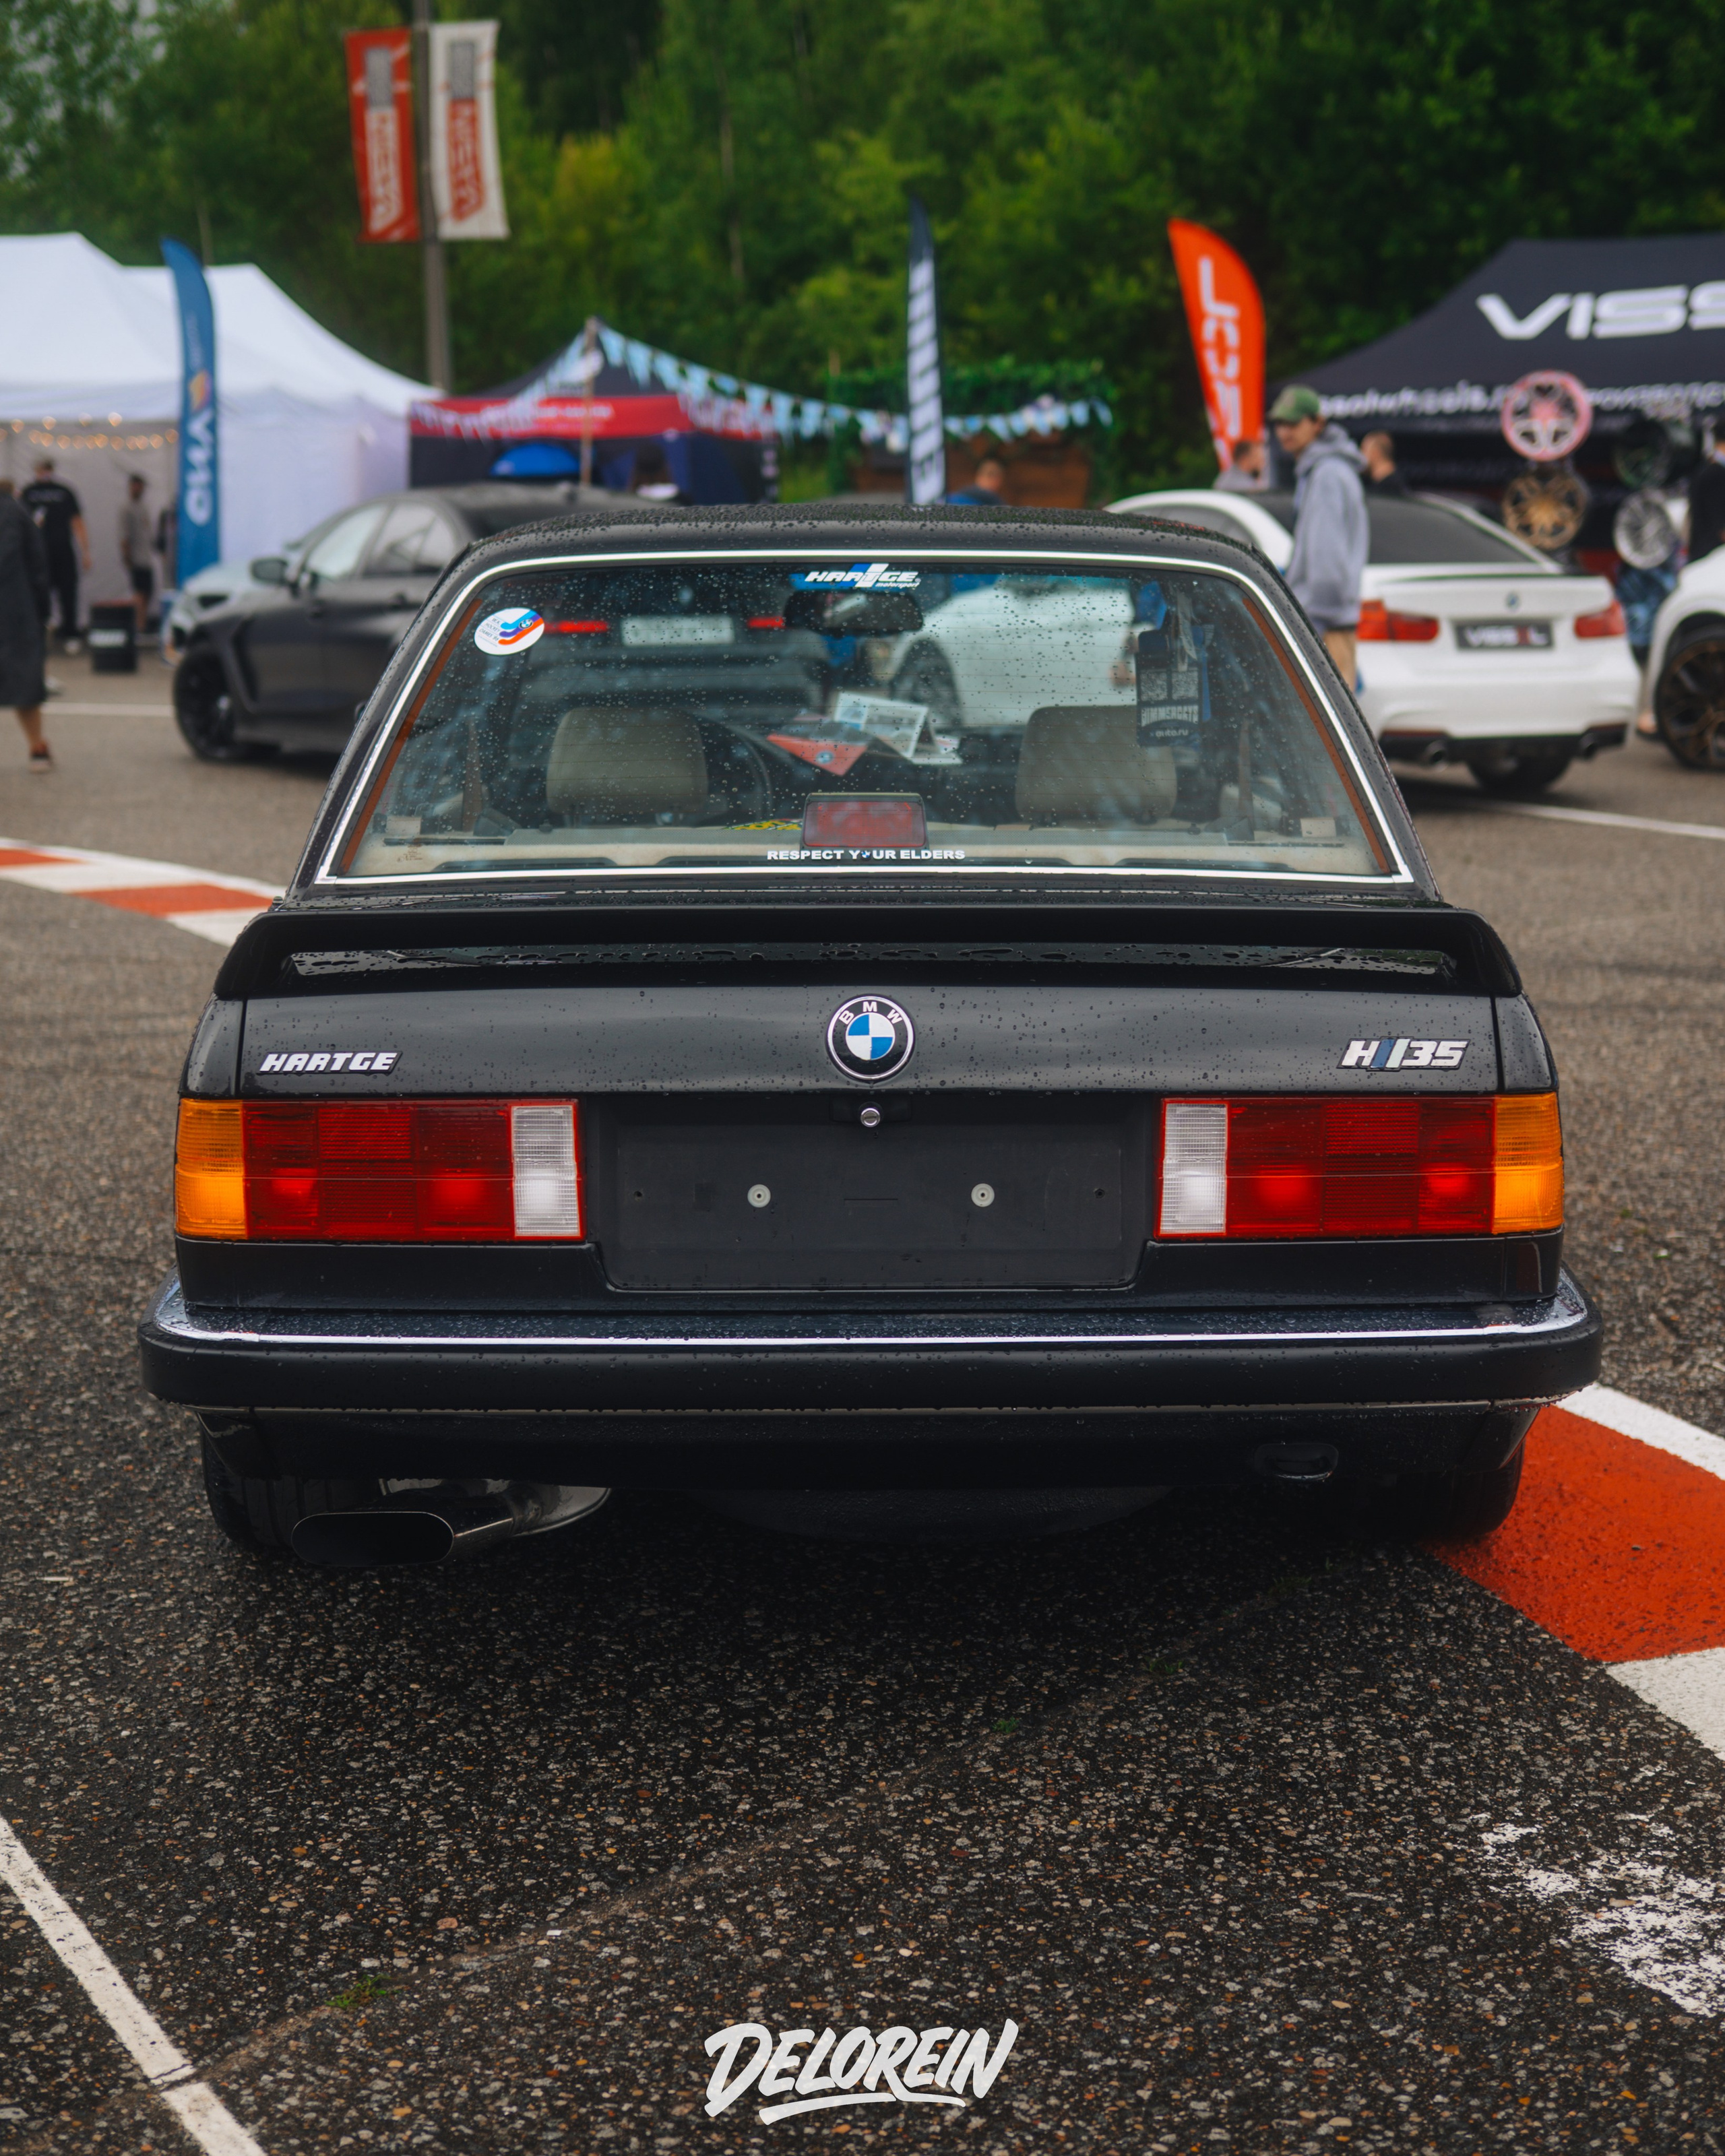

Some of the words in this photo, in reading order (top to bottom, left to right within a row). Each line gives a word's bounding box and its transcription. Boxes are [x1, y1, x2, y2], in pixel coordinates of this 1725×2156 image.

[805, 571, 919, 582] HARTGE
[1155, 729, 1189, 738] auto.ru
[767, 850, 844, 860] RESPECT
[900, 850, 966, 860] ELDERS
[838, 1001, 903, 1025] BMW
[259, 1052, 398, 1072] HARTGE
